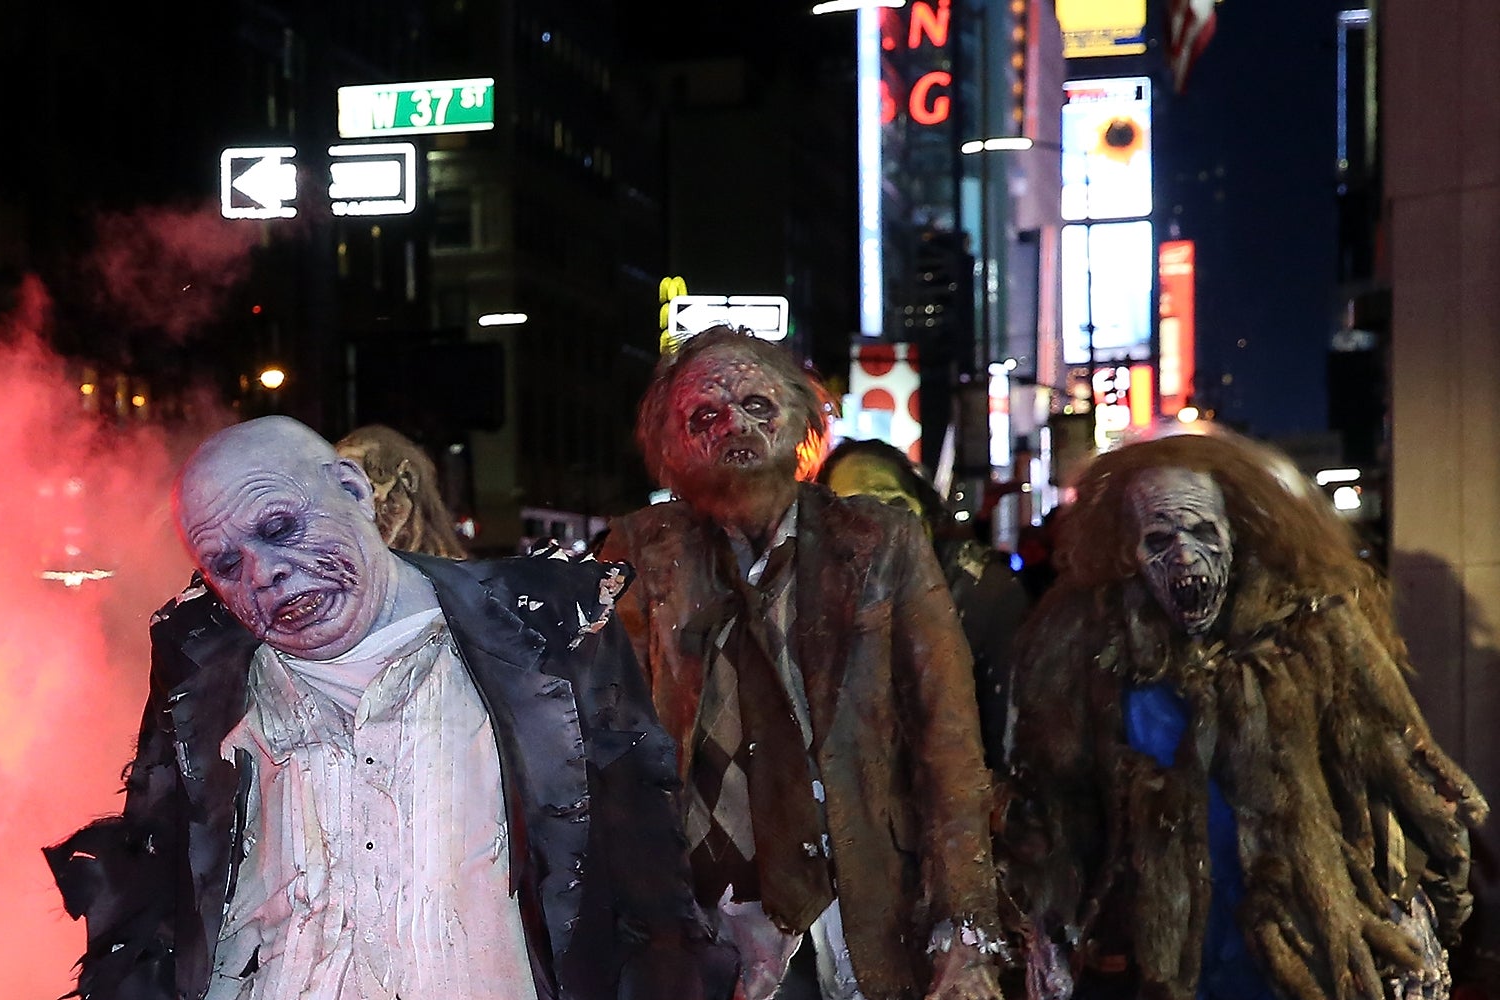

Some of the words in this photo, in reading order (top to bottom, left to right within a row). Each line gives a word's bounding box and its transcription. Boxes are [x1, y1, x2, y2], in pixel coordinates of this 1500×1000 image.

[372, 91, 400, 129] W
[410, 88, 453, 127] 37
[460, 86, 487, 109] ST
